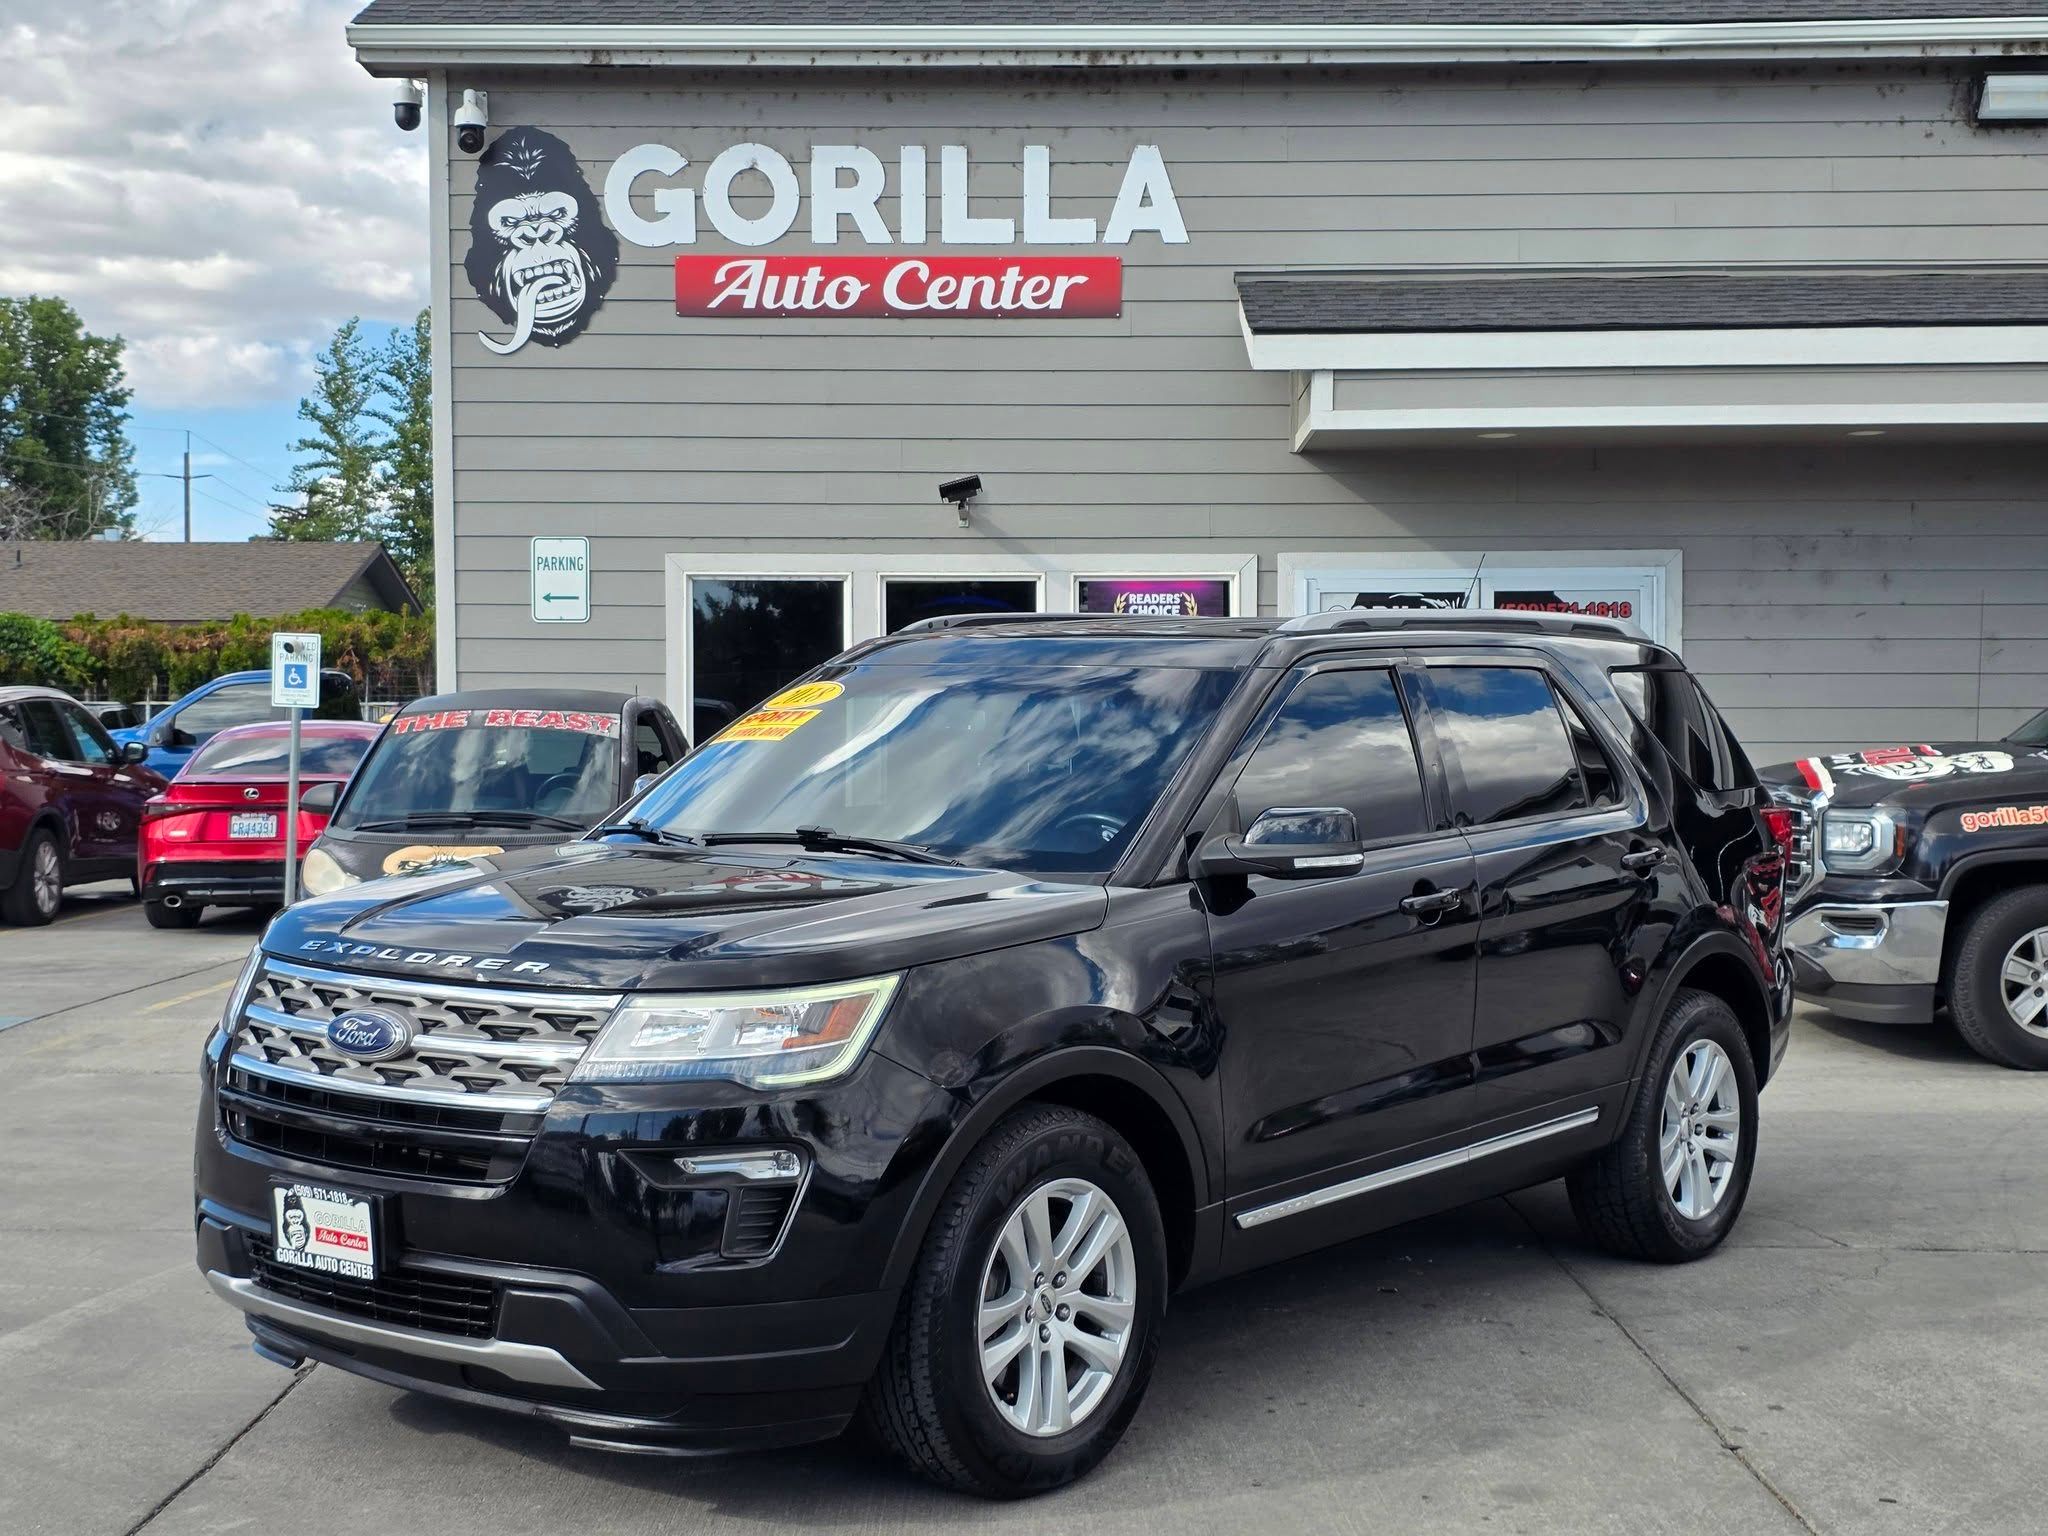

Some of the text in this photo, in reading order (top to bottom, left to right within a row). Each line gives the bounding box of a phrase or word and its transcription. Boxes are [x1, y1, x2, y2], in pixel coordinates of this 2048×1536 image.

[604, 143, 1189, 248] GORILLA
[707, 258, 1089, 310] Auto Center
[537, 556, 584, 571] PARKING
[1128, 593, 1182, 604] READERS'
[1128, 605, 1181, 616] CHOICE
[280, 653, 313, 662] PARKING
[393, 709, 619, 736] THE BEAST
[299, 940, 551, 974] EXPLORER
[336, 1017, 382, 1047] Ford
[313, 1188, 348, 1206] 571-1818
[314, 1210, 368, 1233] GORILLA
[318, 1229, 368, 1249] Auto Center
[315, 1255, 338, 1272] AUTO
[340, 1260, 374, 1280] CENTER
